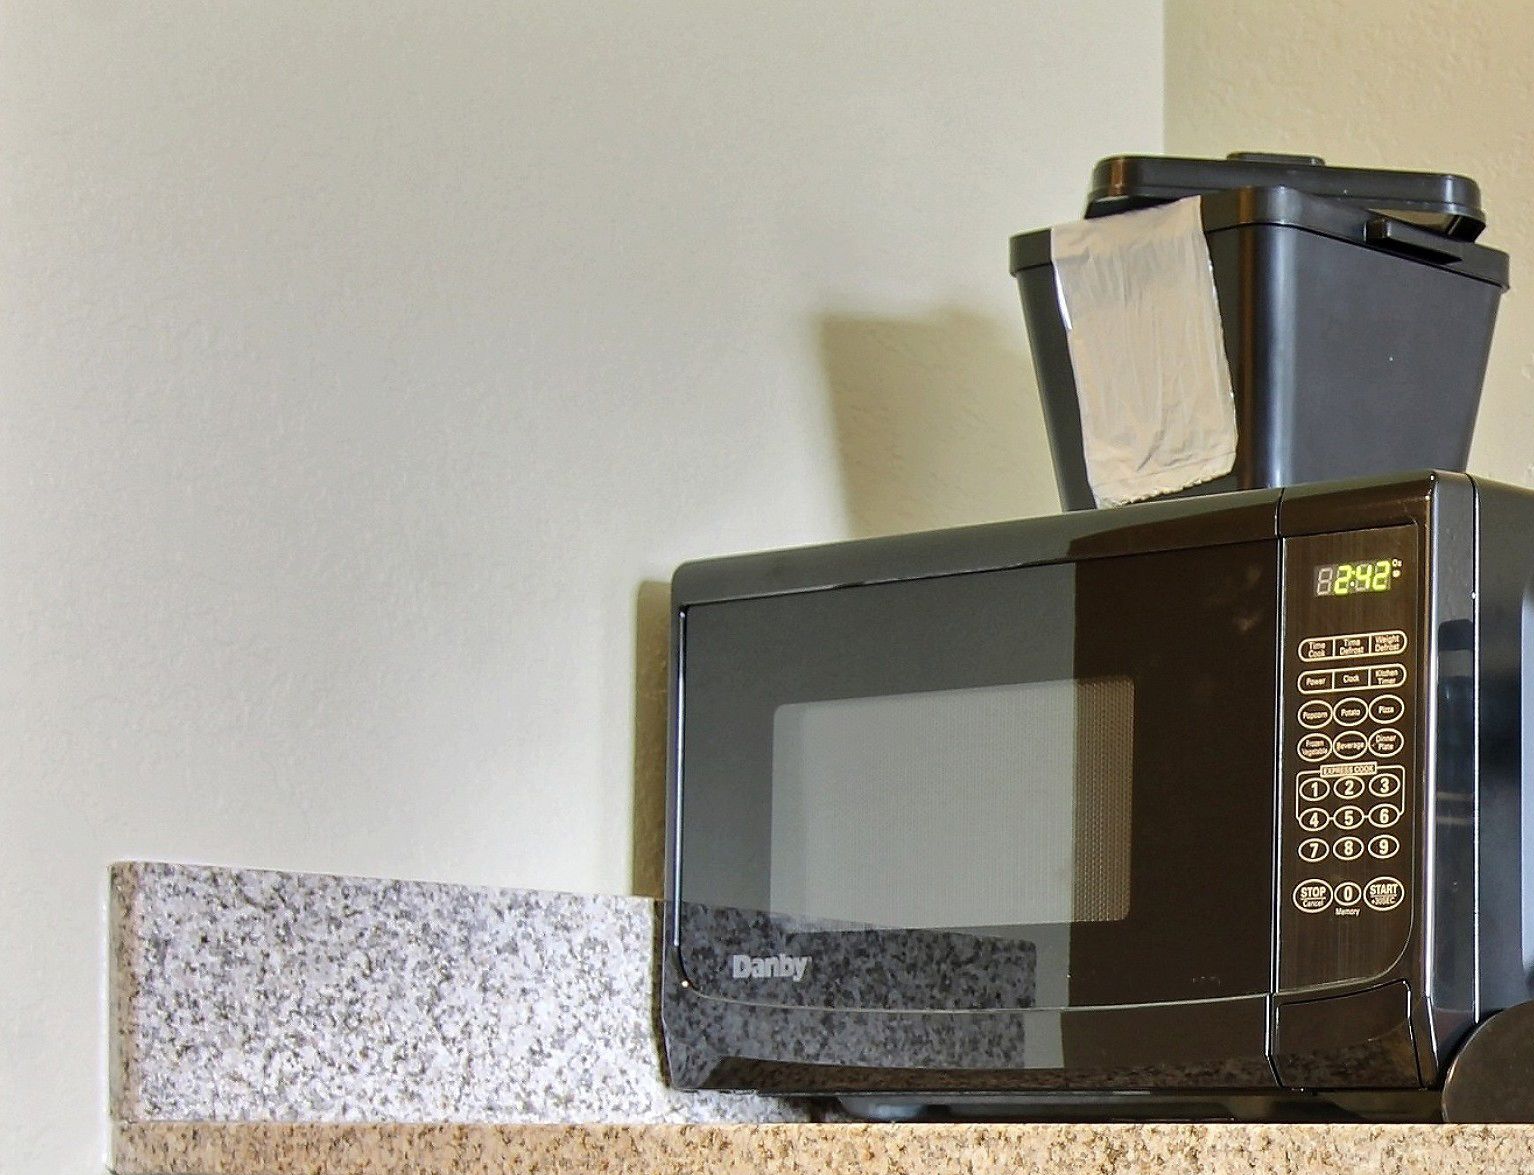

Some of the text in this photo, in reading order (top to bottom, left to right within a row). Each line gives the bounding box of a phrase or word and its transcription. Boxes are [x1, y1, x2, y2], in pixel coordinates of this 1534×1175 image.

[1306, 677, 1327, 686] Power
[1343, 674, 1360, 683] Clock
[1311, 782, 1319, 797] 1
[1344, 780, 1354, 796] 2
[1380, 778, 1390, 793] 3
[1310, 812, 1319, 828] 4
[1344, 810, 1354, 826] 5
[1379, 808, 1389, 824] 6
[1309, 842, 1319, 858] 7
[1344, 840, 1354, 856] 8
[1379, 839, 1389, 855] 9
[1300, 886, 1327, 898] STOP
[1343, 885, 1353, 902] 0
[1369, 883, 1398, 895] START
[1302, 898, 1324, 908] Cancel
[732, 953, 813, 982] Danby
